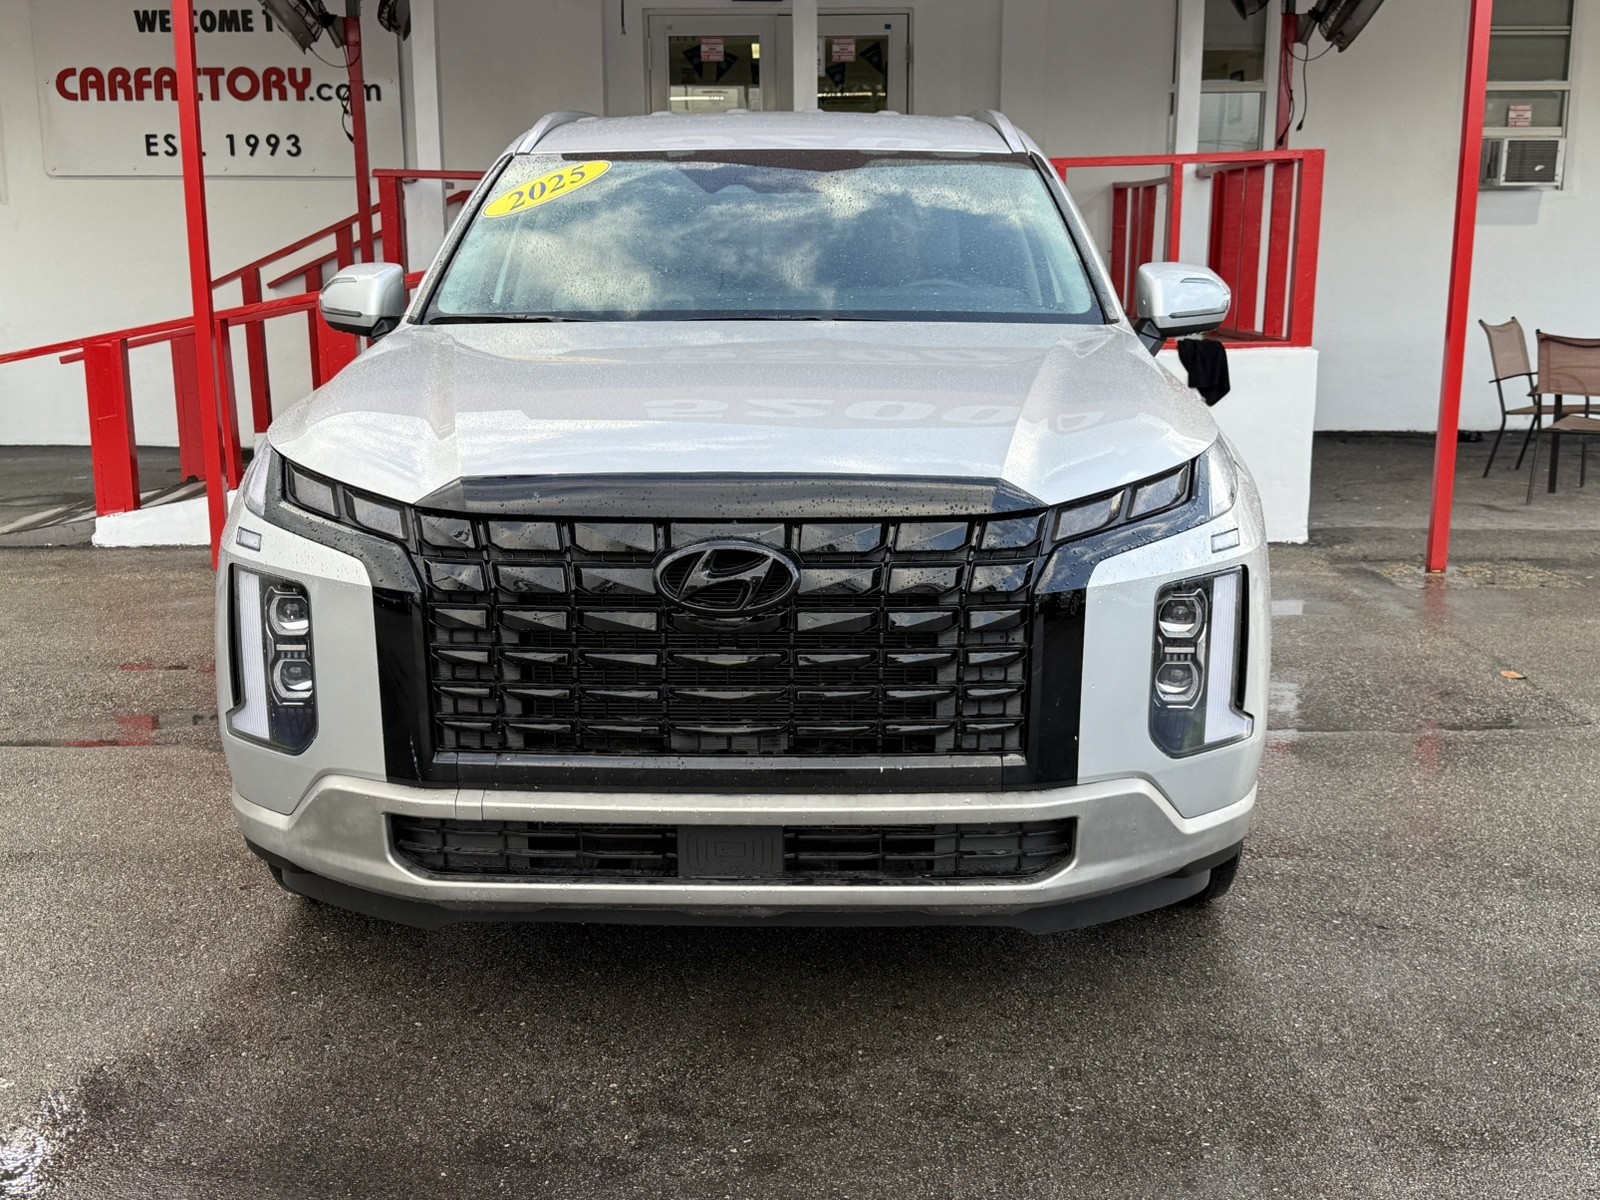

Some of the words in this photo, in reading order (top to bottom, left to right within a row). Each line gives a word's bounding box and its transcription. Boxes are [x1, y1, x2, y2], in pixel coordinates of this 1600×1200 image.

[133, 9, 254, 33] WEOME
[55, 66, 382, 102] CARFATORY.com
[144, 133, 206, 157] ES.
[225, 133, 302, 157] 1993
[507, 165, 586, 211] 2025
